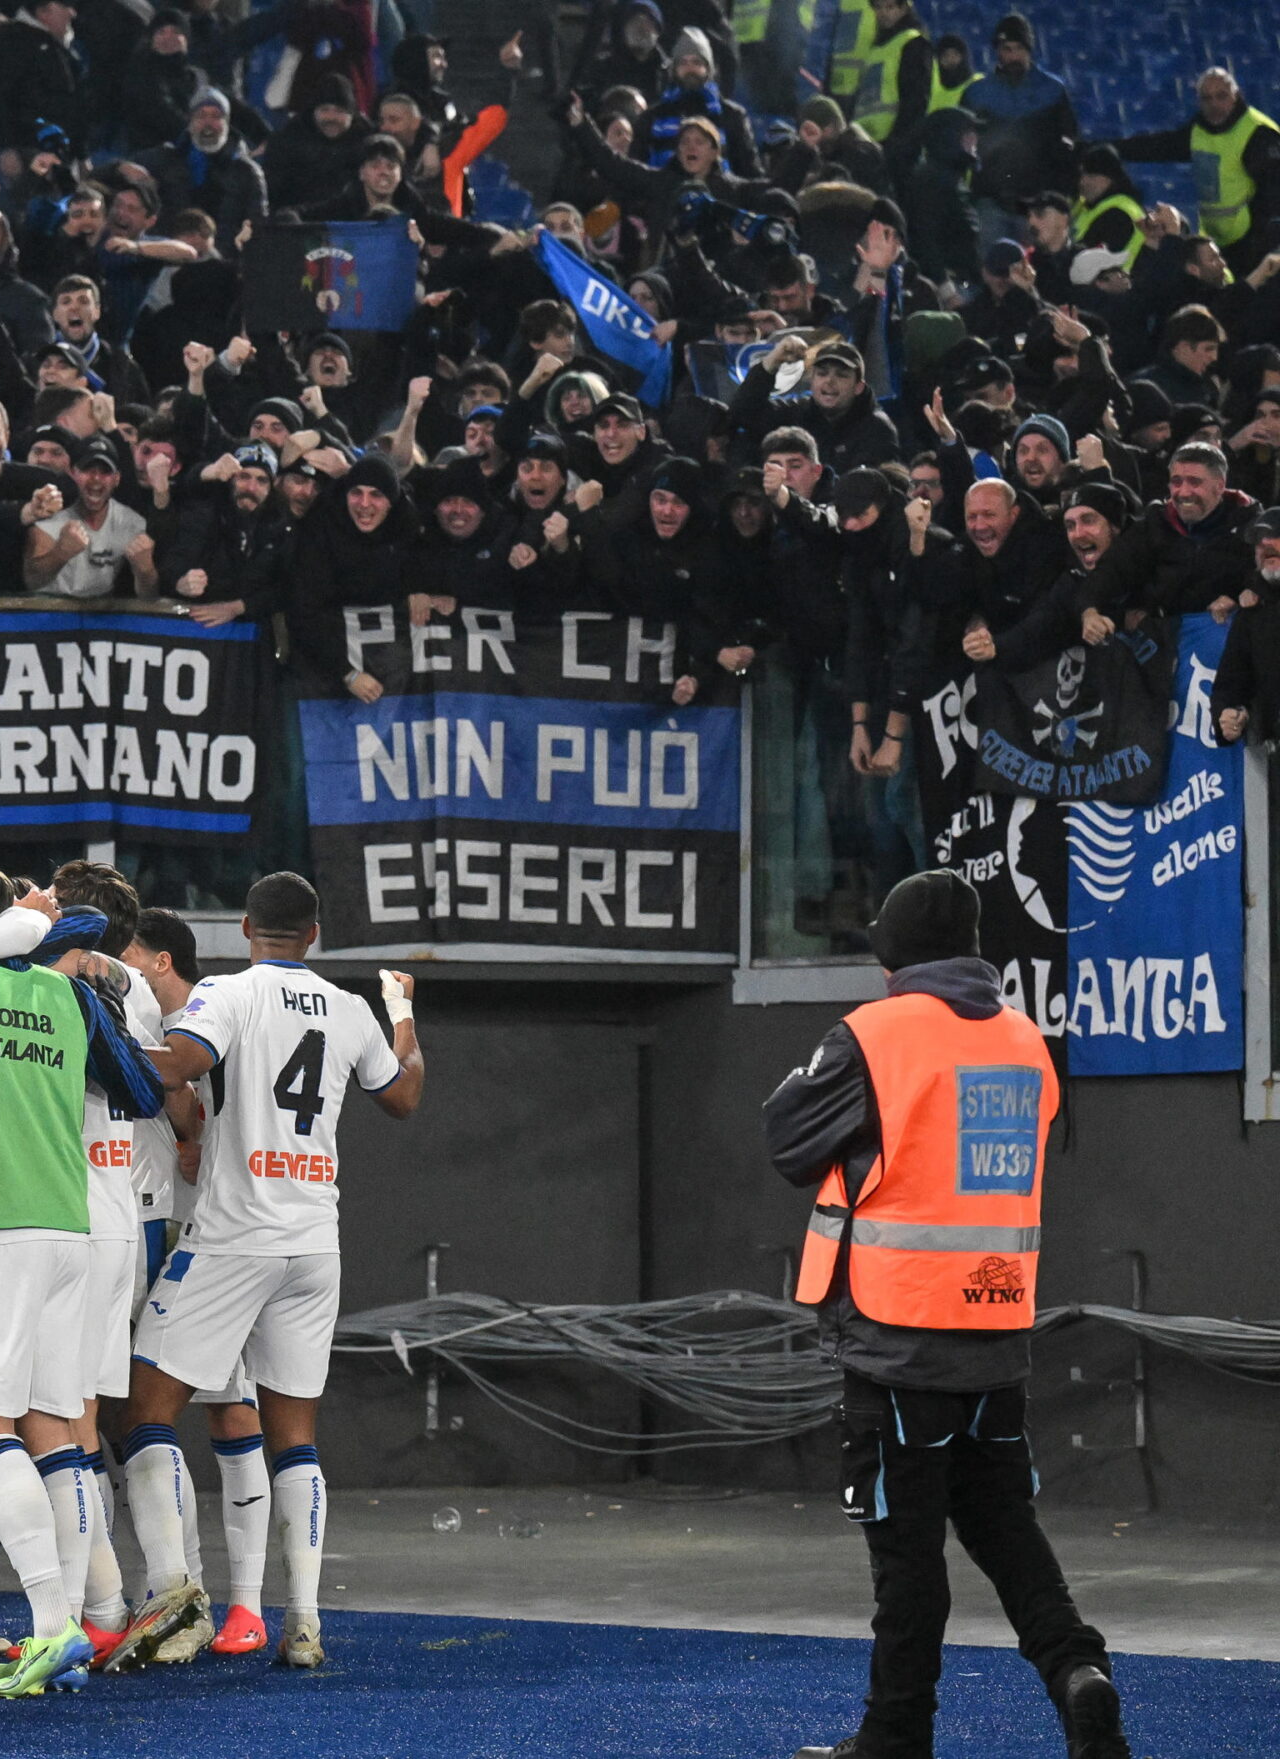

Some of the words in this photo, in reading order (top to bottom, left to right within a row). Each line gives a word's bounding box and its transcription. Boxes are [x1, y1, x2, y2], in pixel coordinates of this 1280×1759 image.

[344, 604, 516, 675] PER
[561, 610, 677, 686] CH
[357, 718, 504, 803] NON
[536, 718, 700, 810] PUÒ
[1144, 768, 1225, 836] walk
[364, 839, 697, 930] ESSERCI
[1152, 824, 1237, 888] alone
[1001, 951, 1227, 1044] ALANTA
[273, 1029, 325, 1136] 4
[248, 1149, 334, 1182] GEWISS
